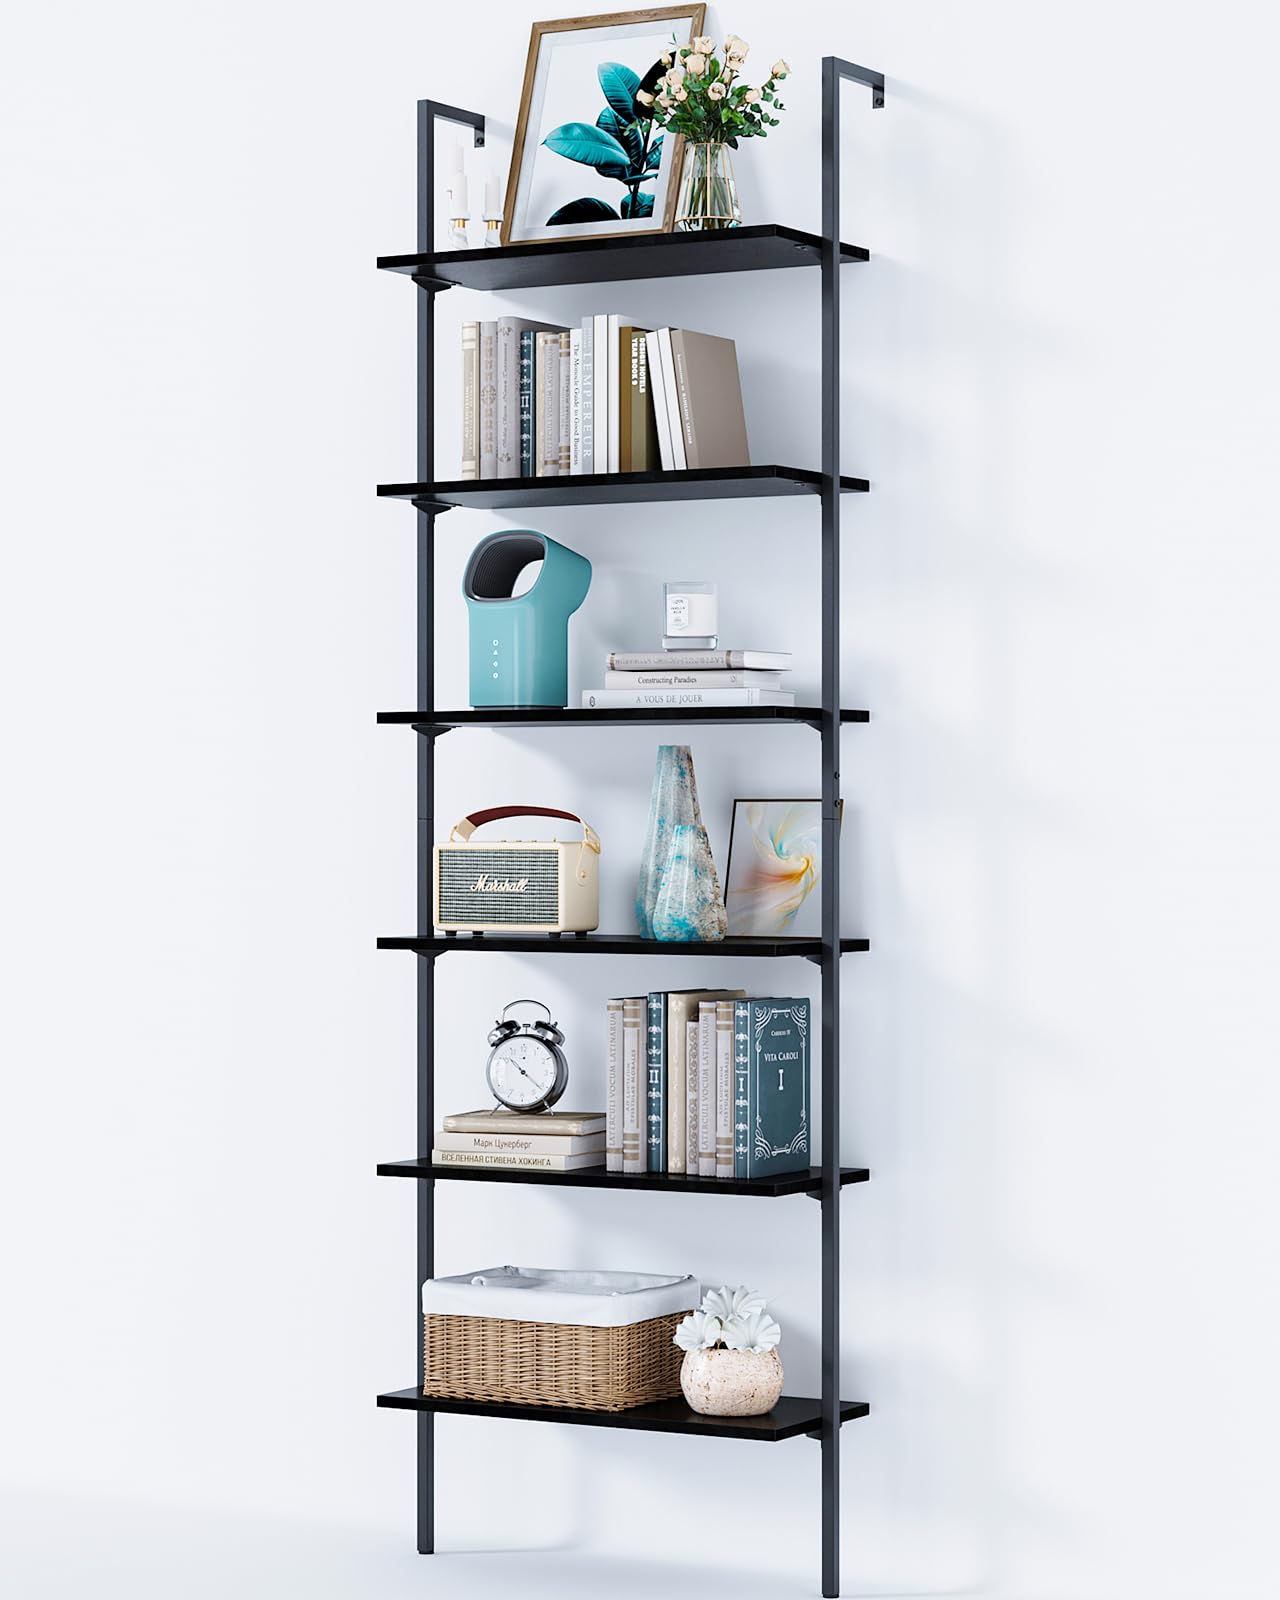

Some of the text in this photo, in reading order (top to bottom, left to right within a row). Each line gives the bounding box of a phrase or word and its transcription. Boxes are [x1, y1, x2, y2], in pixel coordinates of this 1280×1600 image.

[583, 353, 592, 457] LEMPEREUR
[637, 676, 673, 685] Constructing
[644, 695, 664, 703] VOUS
[666, 695, 677, 703] DE
[679, 694, 703, 705] JOUER
[470, 874, 528, 893] Marshall
[609, 1012, 617, 1062] LATINARUM
[702, 1015, 710, 1066] LATINARUM
[764, 1051, 799, 1062] VITA CAROLI
[608, 1098, 616, 1147] LATERCULI
[701, 1102, 709, 1151] LATERCULI
[473, 1138, 532, 1150] Марк Цукерберг
[441, 1153, 551, 1166] ВСЕЛЕННАЯ СТИВЕНА ХОКИНГА
